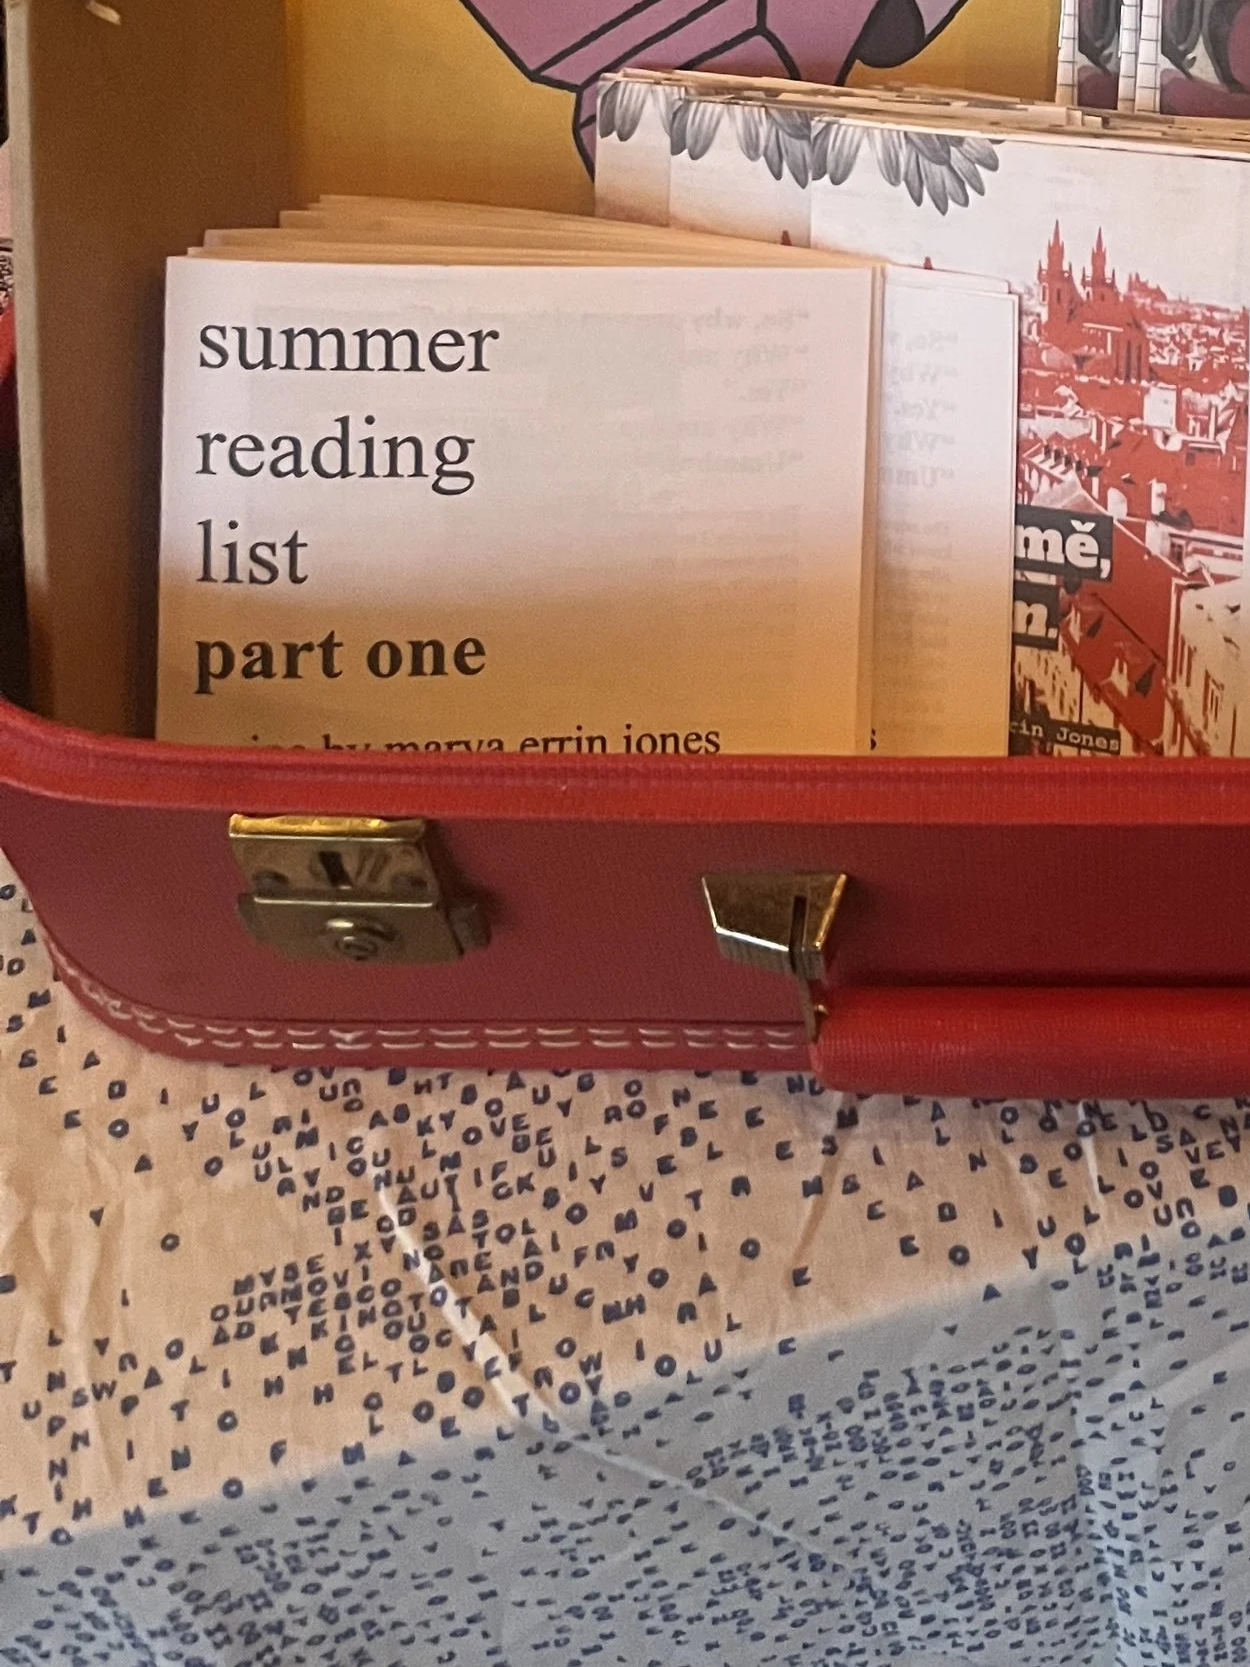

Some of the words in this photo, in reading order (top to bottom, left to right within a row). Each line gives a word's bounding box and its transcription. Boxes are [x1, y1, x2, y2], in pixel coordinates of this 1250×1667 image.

[198, 319, 500, 375] summer
[195, 414, 477, 496] reading
[195, 518, 309, 586] list
[194, 629, 344, 695] part
[366, 628, 487, 679] one
[322, 733, 371, 750] b
[1056, 727, 1119, 751] Jones
